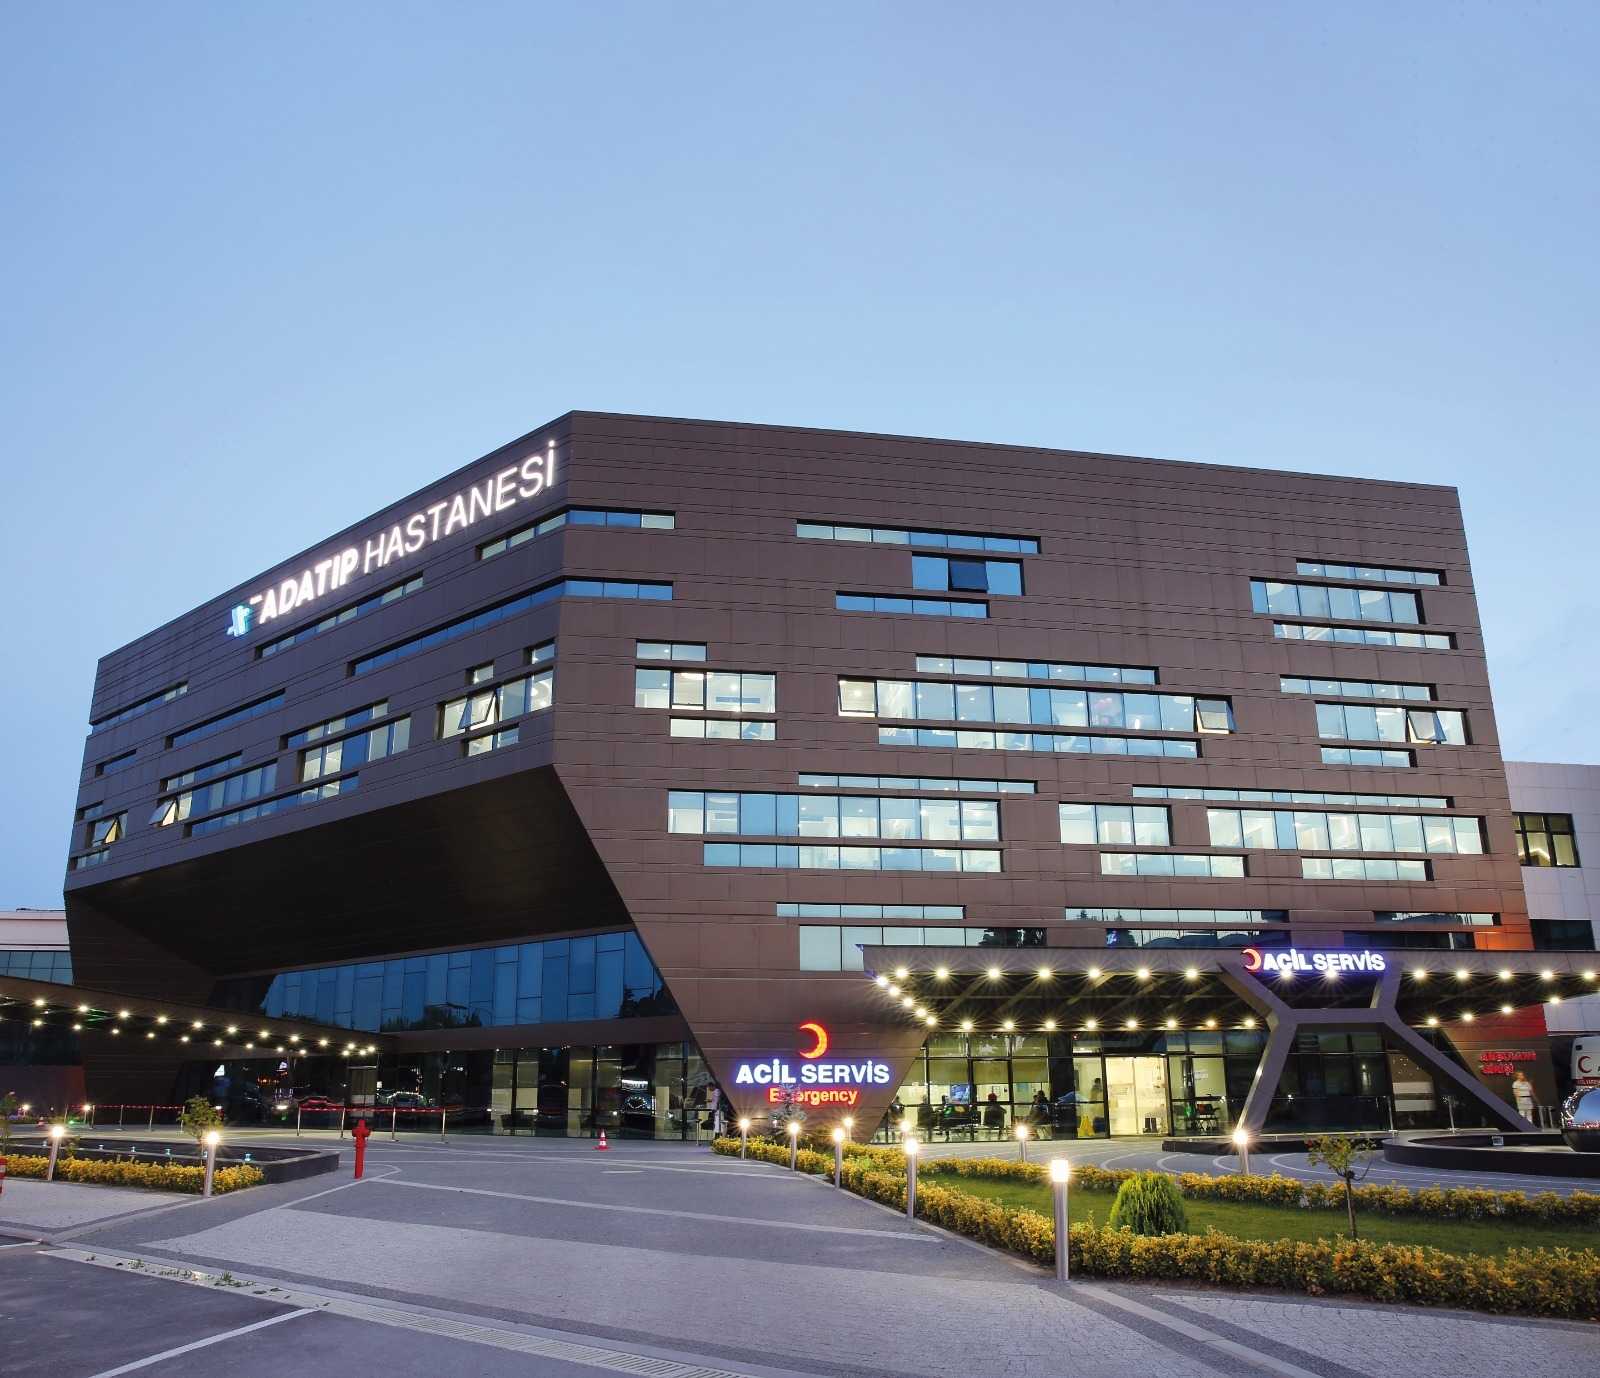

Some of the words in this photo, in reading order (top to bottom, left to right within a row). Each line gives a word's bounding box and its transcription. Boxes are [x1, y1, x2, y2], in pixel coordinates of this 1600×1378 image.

[258, 548, 359, 624] ADATIP
[364, 440, 555, 574] HASTANESİ
[1263, 948, 1313, 970] ACİL
[1313, 950, 1386, 970] SERVİS
[735, 1058, 797, 1083] ACİL
[801, 1060, 890, 1083] SERVİS
